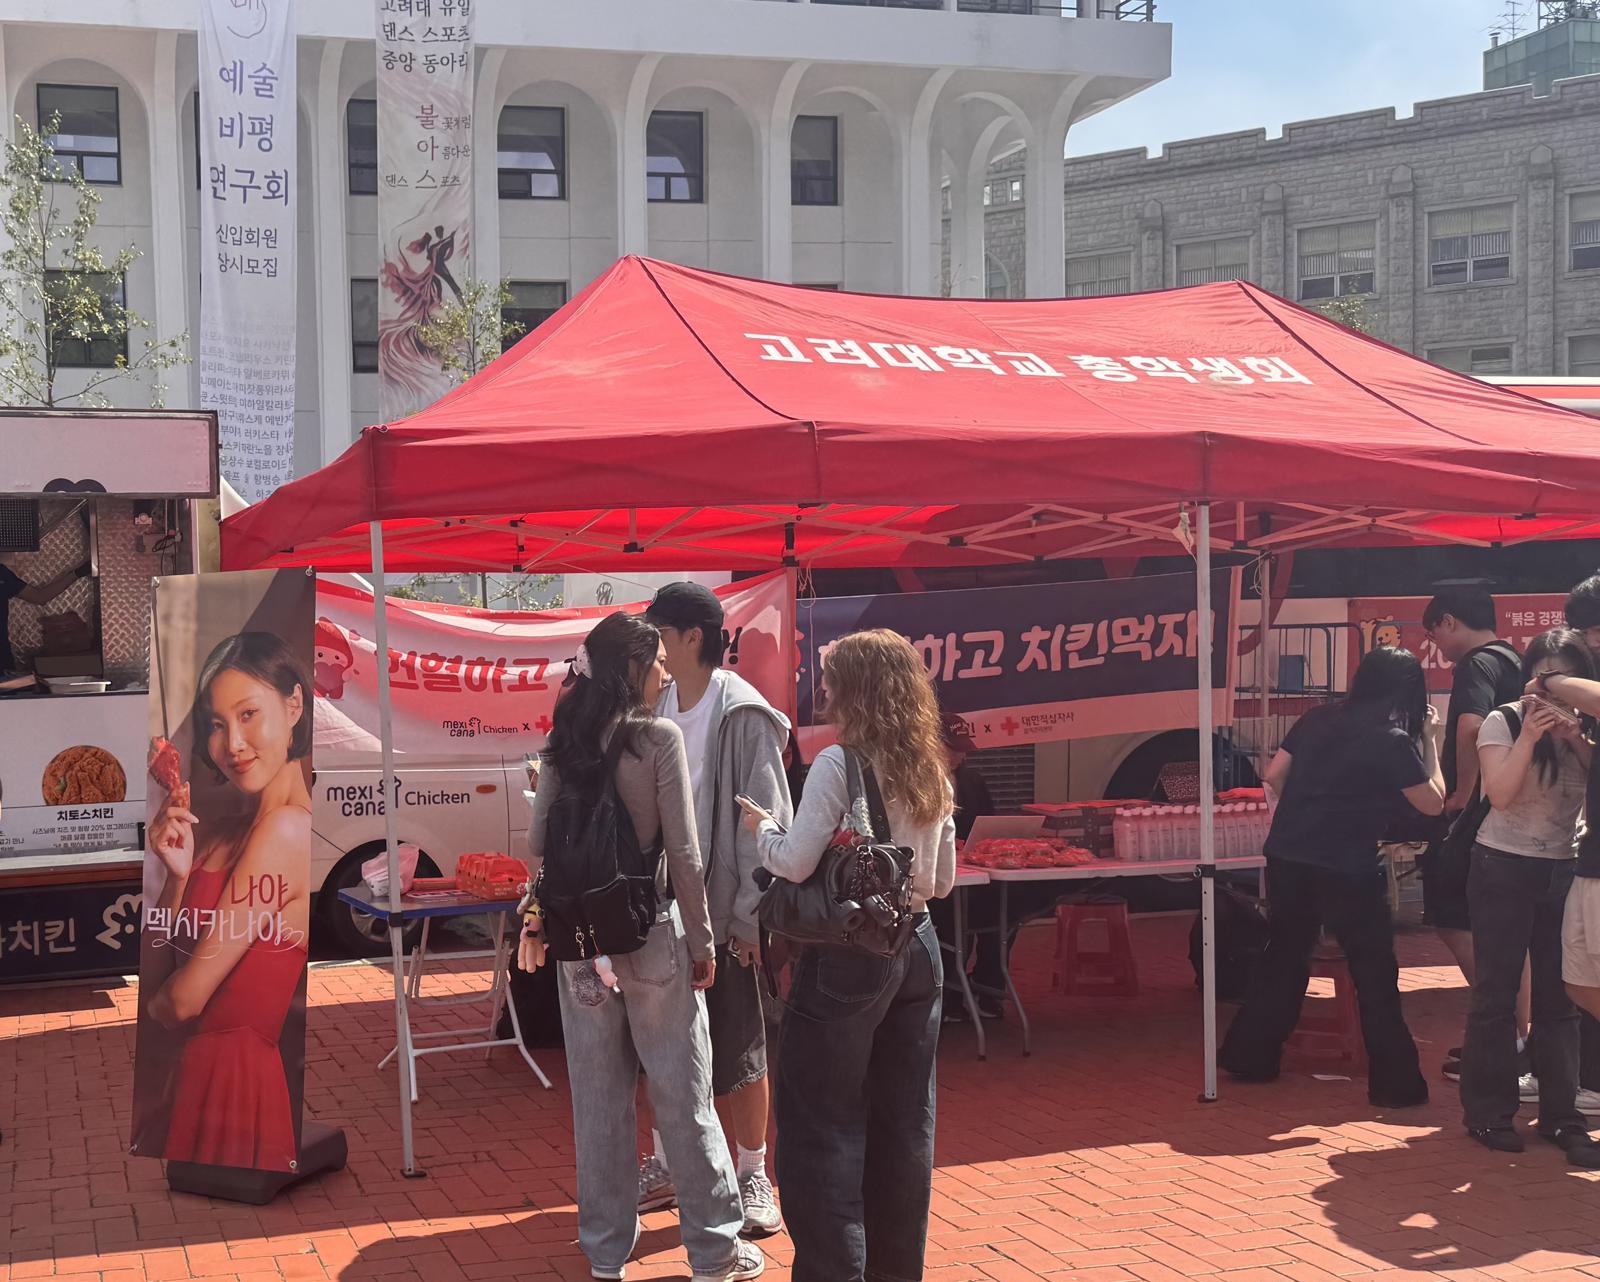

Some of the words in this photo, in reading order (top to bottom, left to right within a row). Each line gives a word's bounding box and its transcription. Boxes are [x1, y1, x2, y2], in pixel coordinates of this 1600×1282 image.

[382, 22, 415, 42] 댄스
[422, 25, 470, 43] 스포츠
[382, 50, 416, 73] 중앙
[422, 51, 468, 74] 동아리
[219, 58, 279, 99] 예술
[219, 112, 274, 152] 비평
[210, 163, 290, 206] 연구회
[216, 224, 279, 249] 신입회원
[217, 252, 278, 277] 상시모집
[743, 332, 1067, 378] 고려대학교
[1067, 352, 1315, 386] 총학생회
[1016, 609, 1215, 672] 치킨먹자
[442, 720, 467, 729] mexi
[450, 728, 475, 738] cana
[483, 724, 518, 734] Chicken
[326, 785, 373, 801] mexi
[404, 790, 471, 806] Chicken
[56, 807, 114, 821] 치토스치킨
[231, 873, 288, 911] 나야
[0, 917, 77, 958] 치킨
